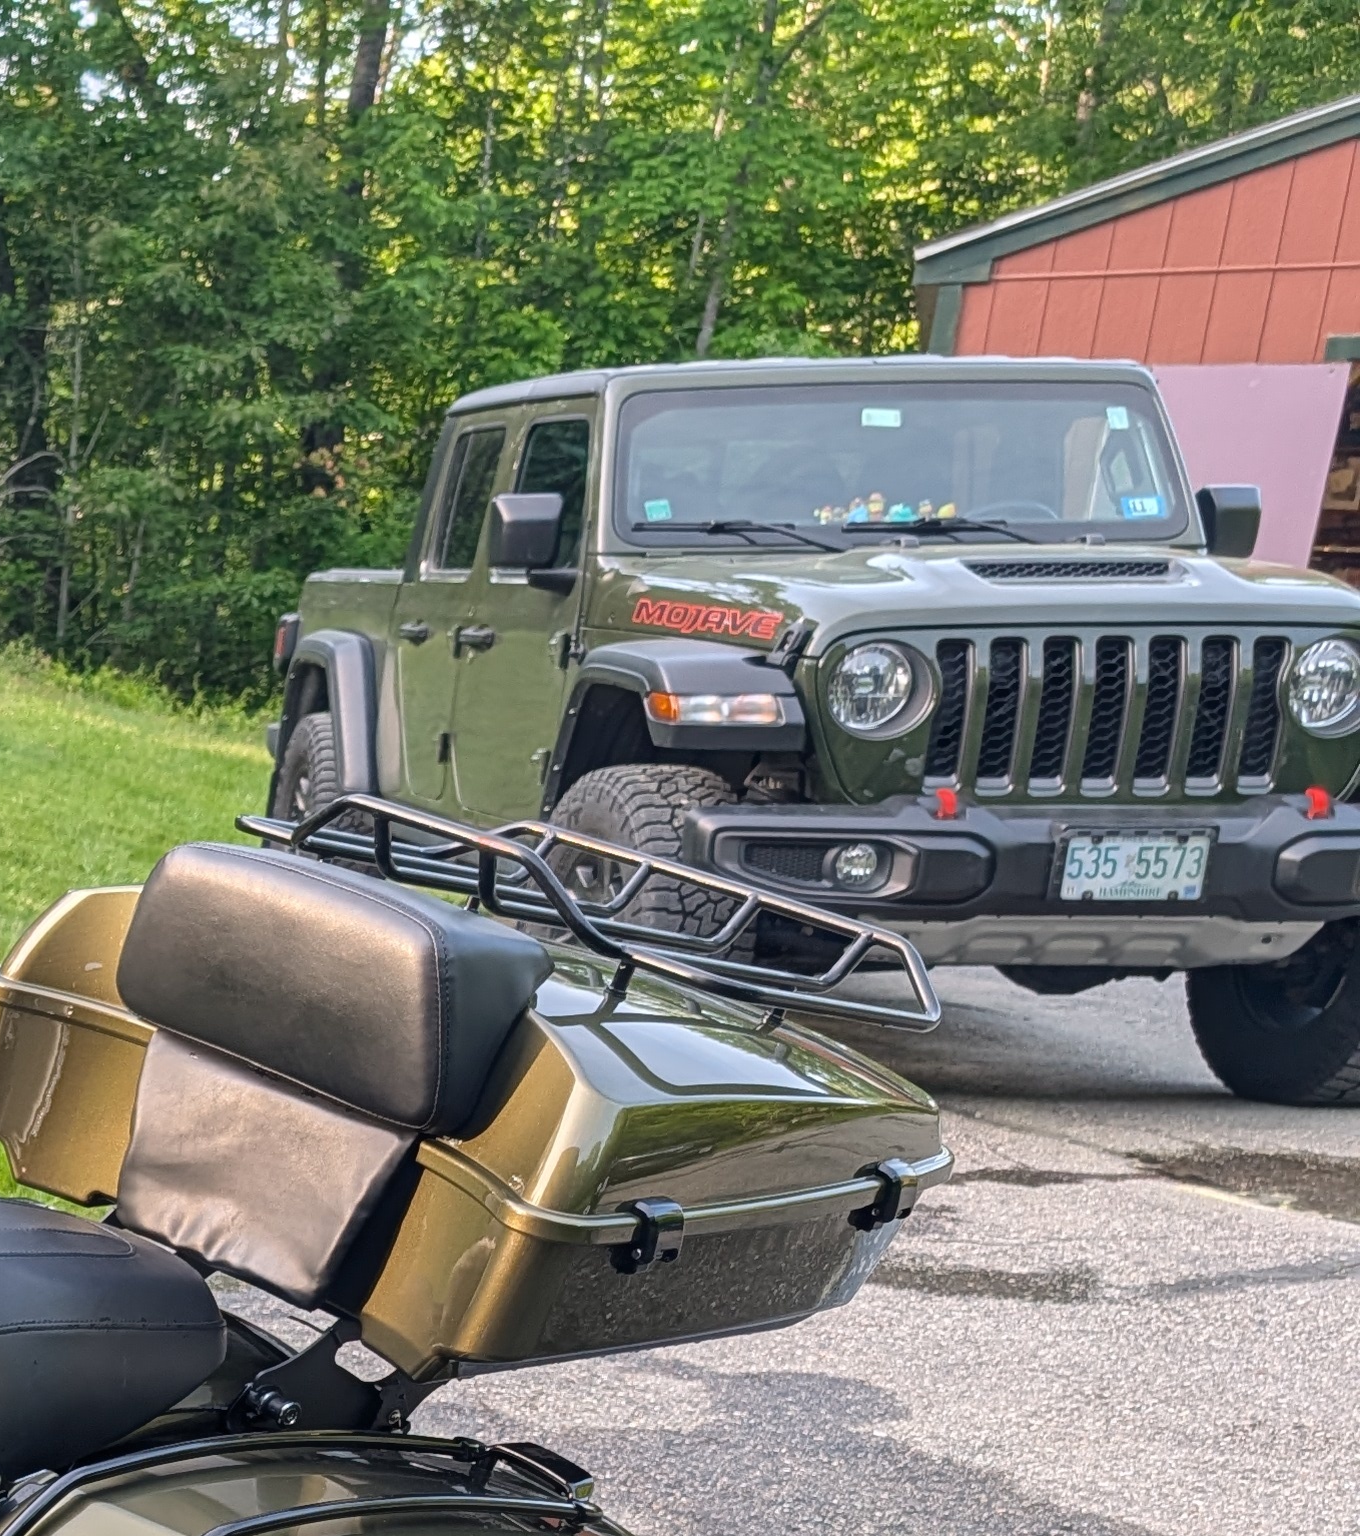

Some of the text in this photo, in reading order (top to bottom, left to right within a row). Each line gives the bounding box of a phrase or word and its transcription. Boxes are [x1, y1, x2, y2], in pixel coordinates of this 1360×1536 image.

[631, 597, 784, 640] MOJAVE
[1066, 846, 1204, 880] 535 5573
